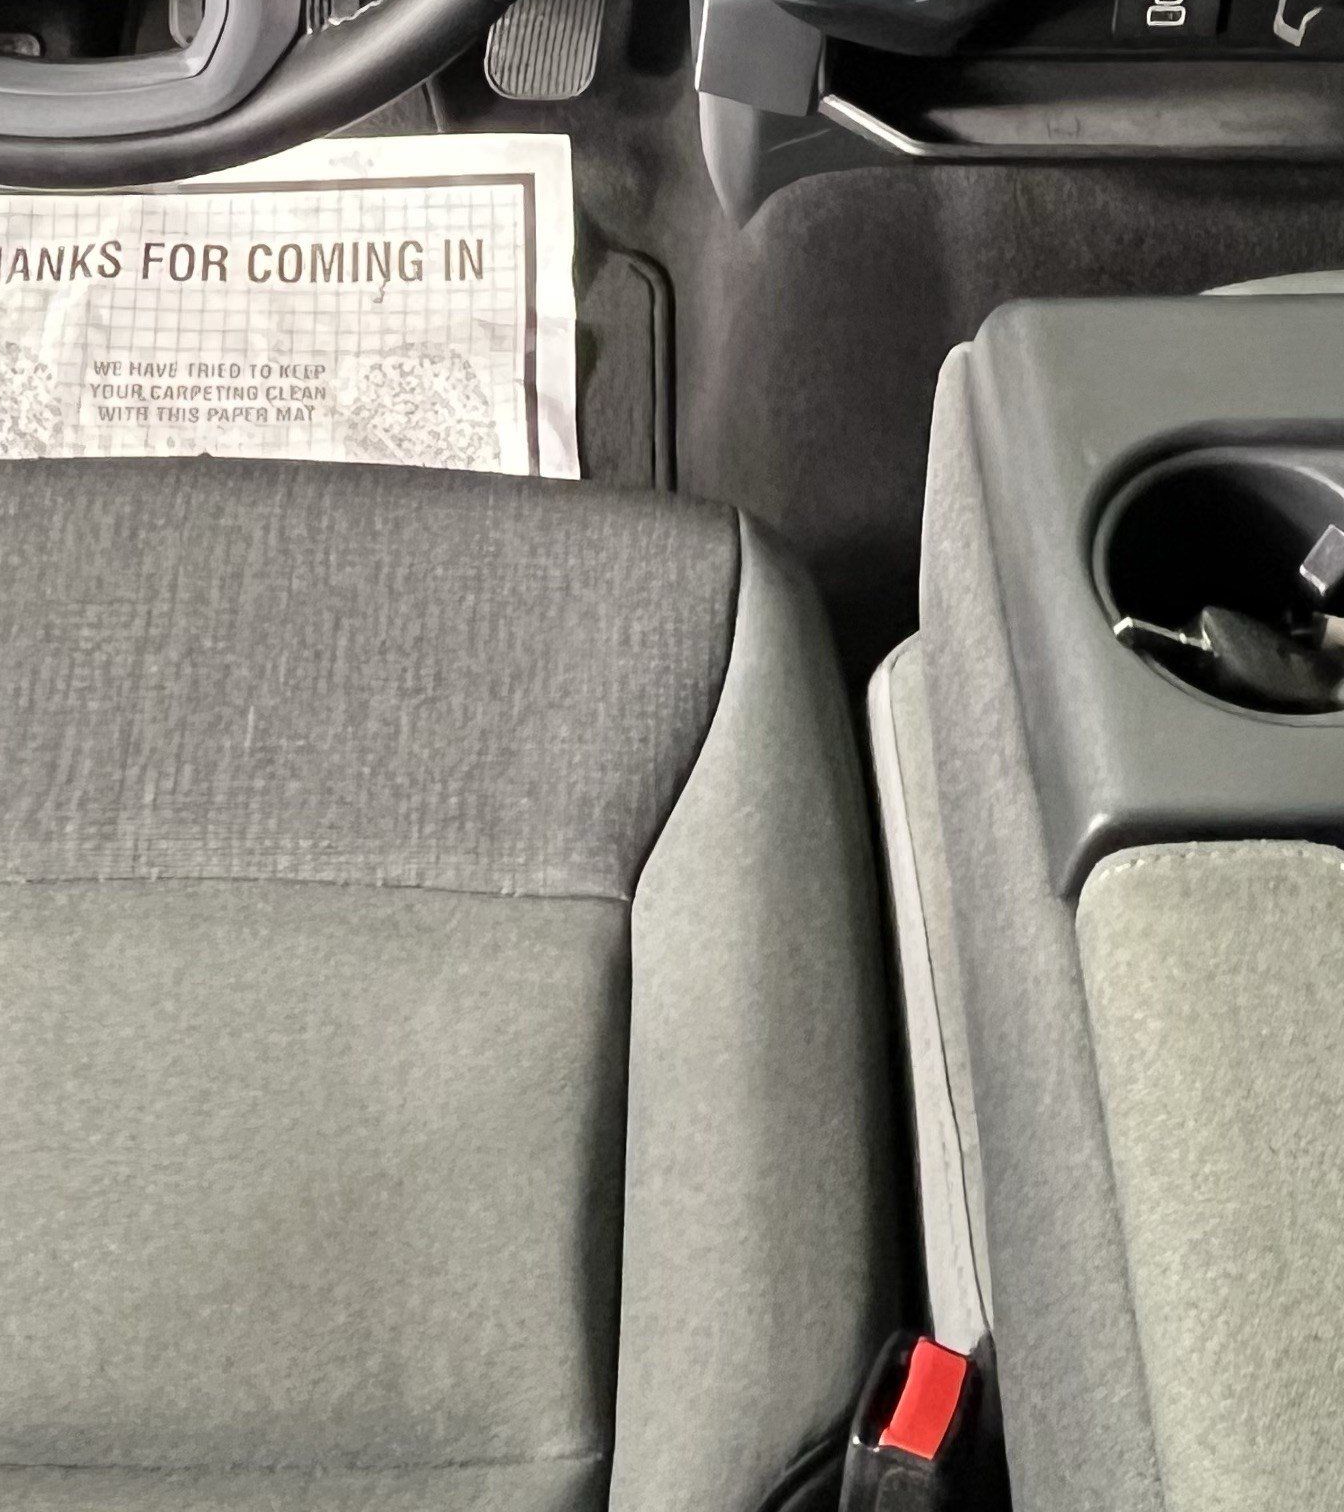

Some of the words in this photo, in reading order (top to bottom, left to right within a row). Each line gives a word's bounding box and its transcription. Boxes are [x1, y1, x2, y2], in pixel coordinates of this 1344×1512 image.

[142, 242, 229, 282] FOR
[248, 239, 424, 283] COMING
[444, 238, 484, 281] IN
[93, 360, 123, 377] WE
[129, 361, 178, 378] HAVE
[188, 362, 241, 379] TRIED
[249, 363, 272, 379] TO
[89, 383, 144, 401] YOUR
[150, 384, 258, 402] CARPETING
[98, 405, 150, 422] WITH
[157, 406, 200, 423] THIS
[206, 406, 268, 423] PAPER
